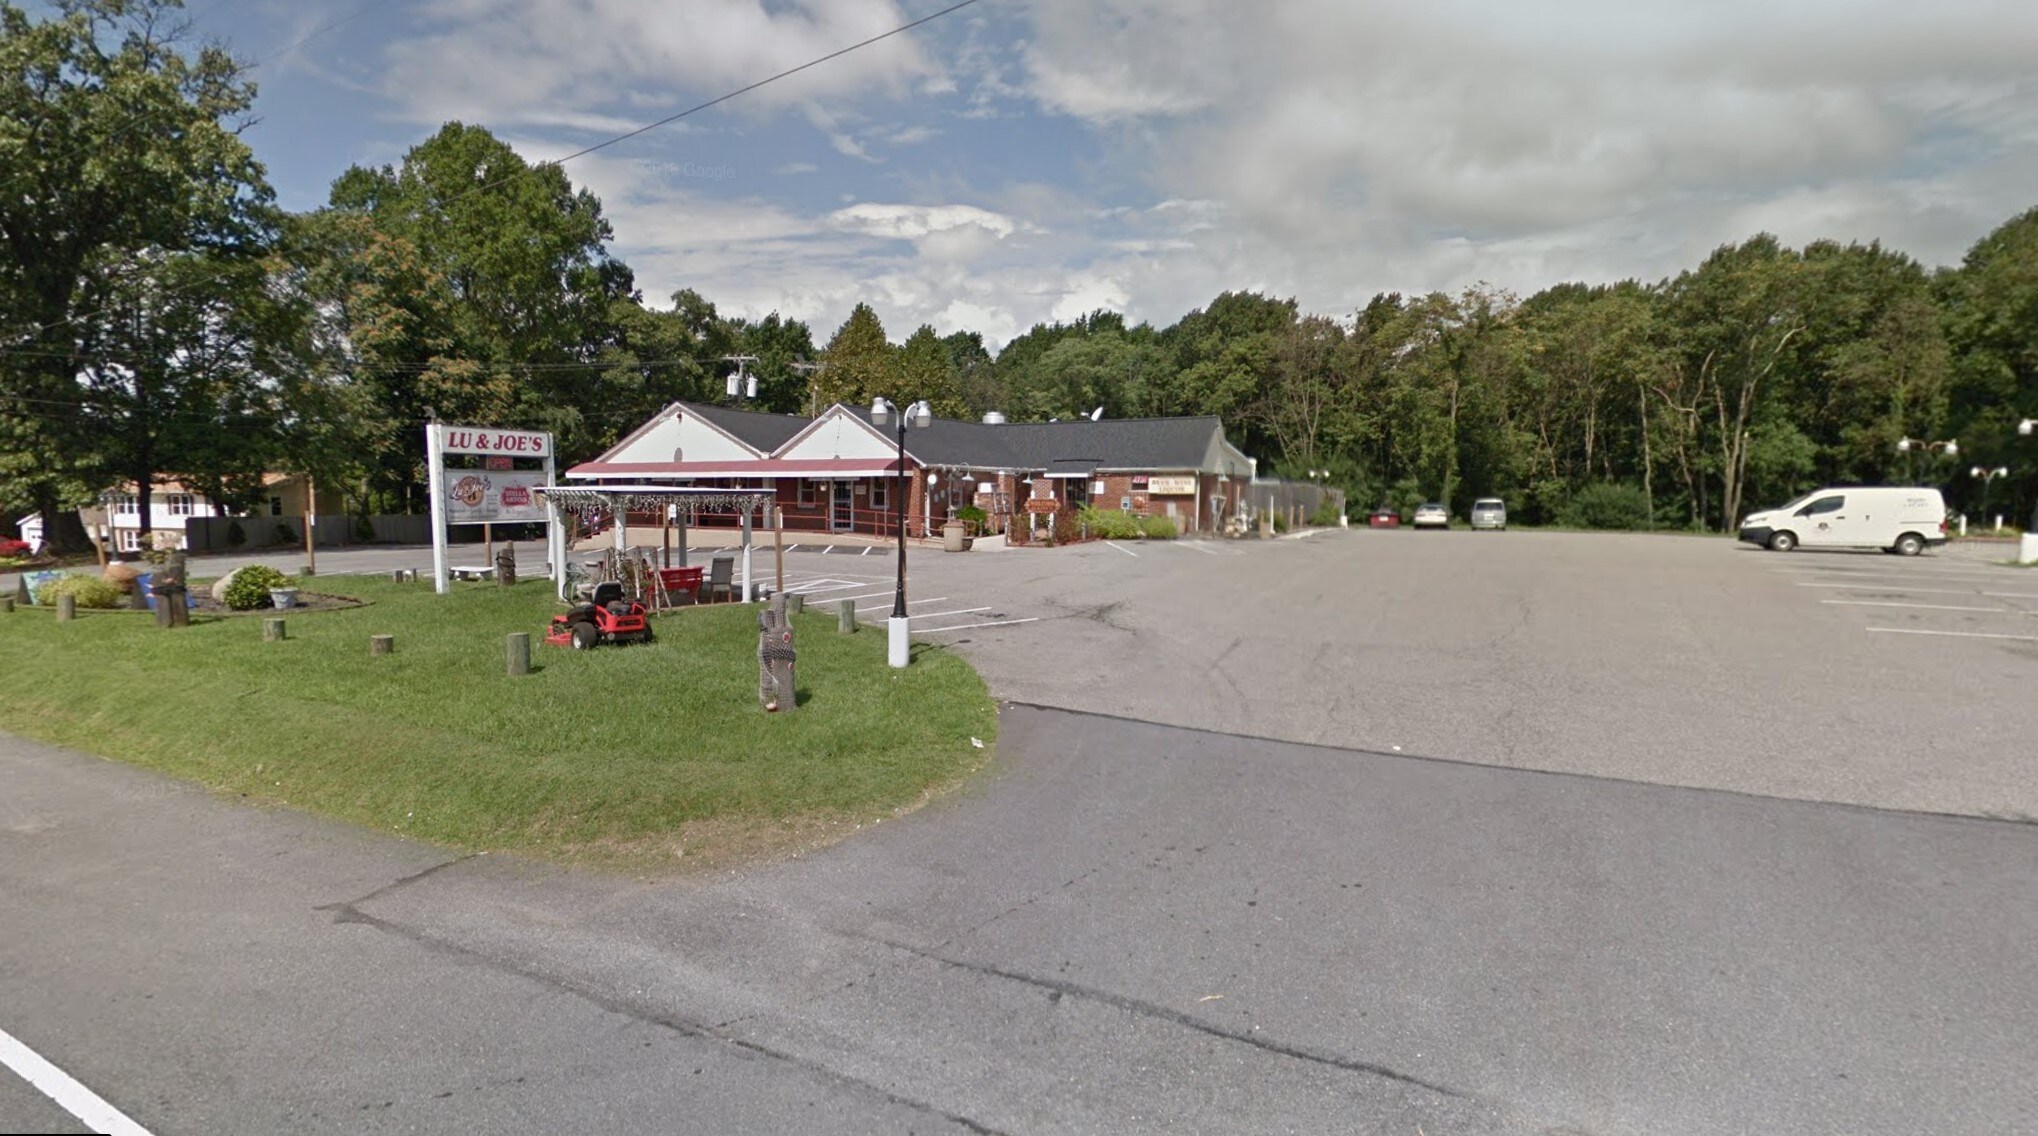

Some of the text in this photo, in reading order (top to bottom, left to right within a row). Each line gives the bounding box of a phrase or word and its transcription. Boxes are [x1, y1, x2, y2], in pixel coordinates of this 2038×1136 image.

[449, 432, 543, 452] LU & JOE'S
